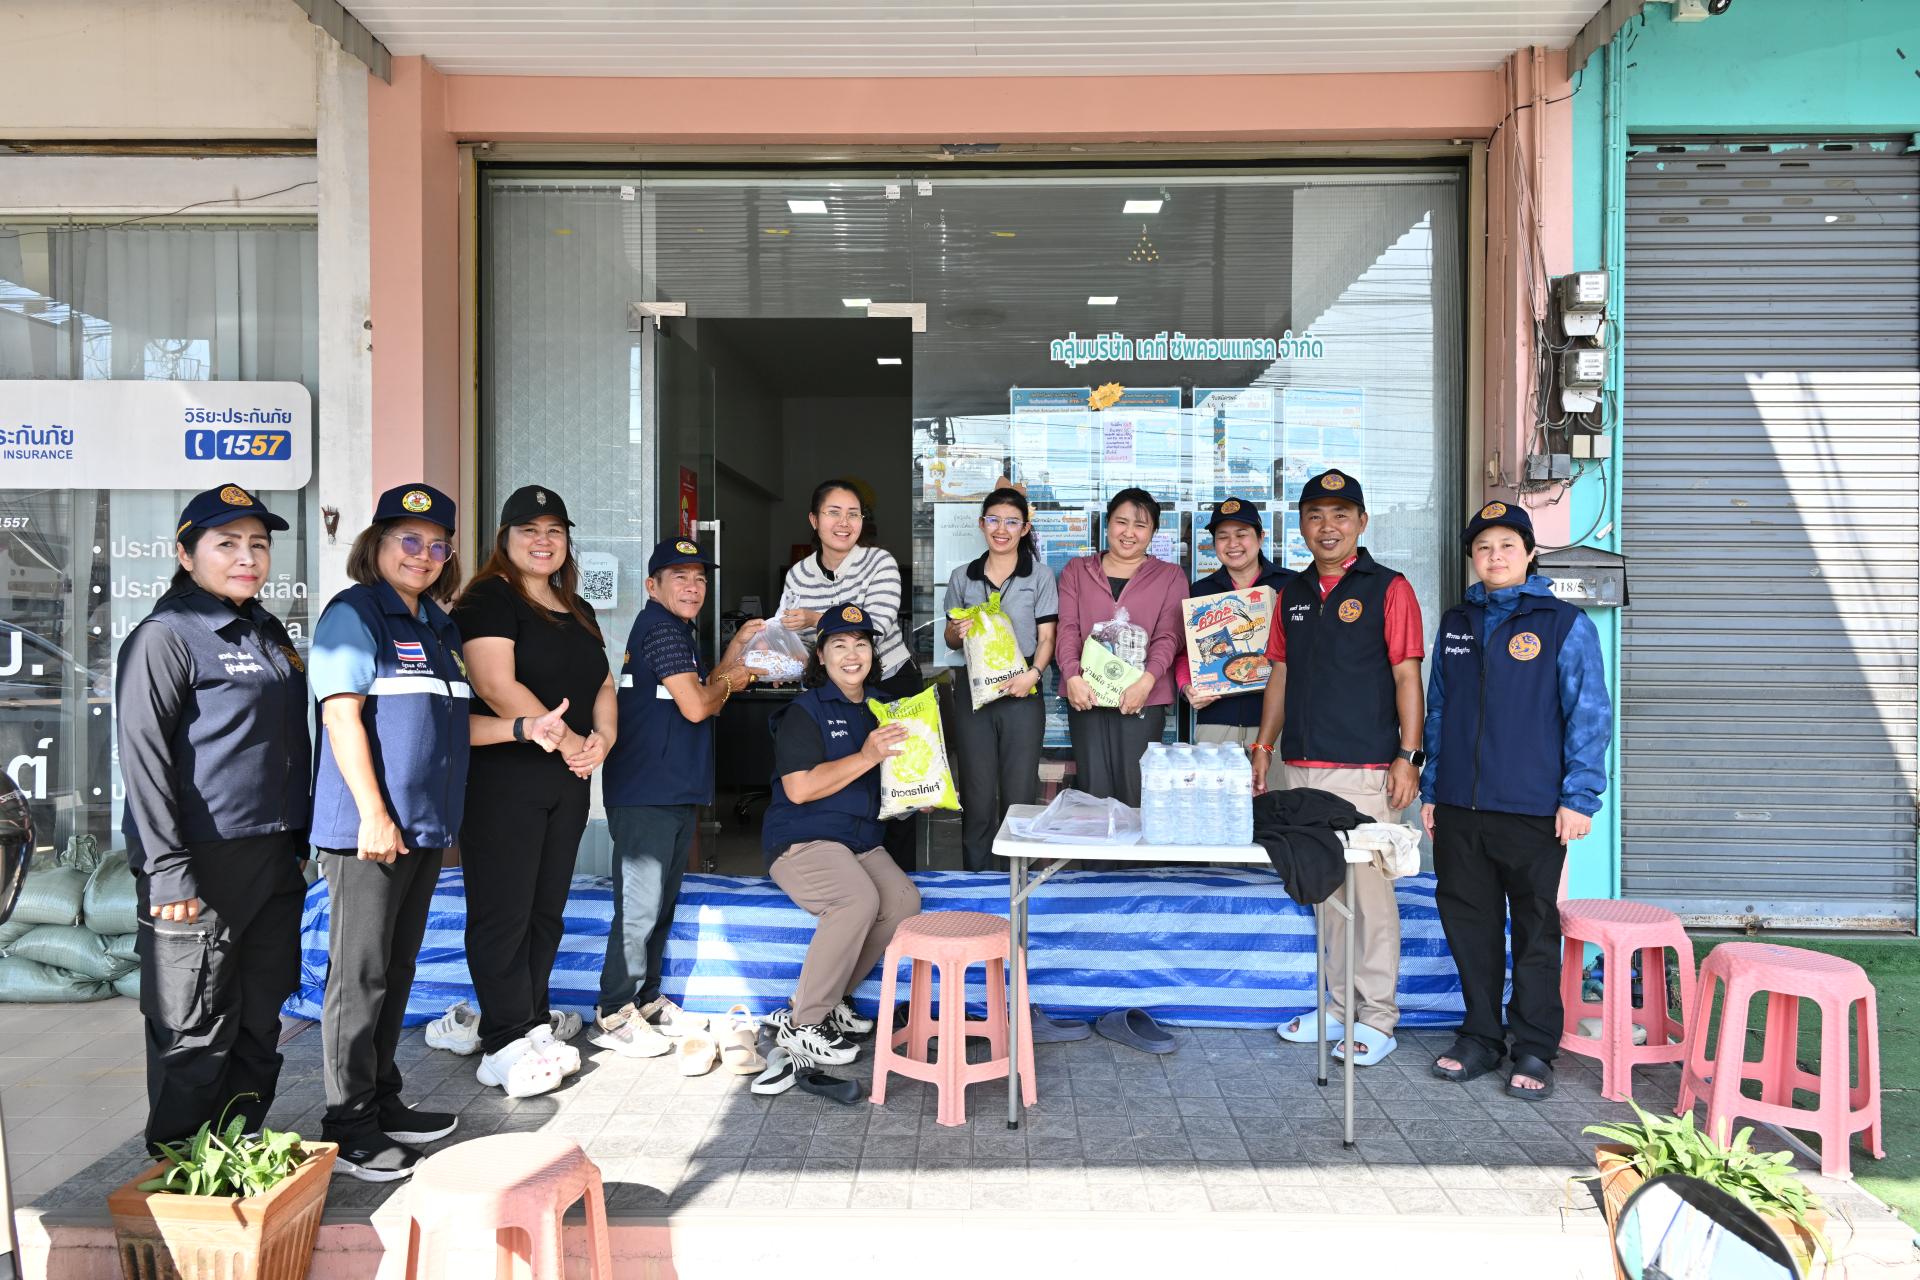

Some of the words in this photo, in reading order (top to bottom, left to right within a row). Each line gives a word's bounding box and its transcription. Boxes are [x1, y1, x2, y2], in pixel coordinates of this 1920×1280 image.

[1050, 332, 1133, 368] กลุ่มบริษัท
[1279, 330, 1324, 360] จำกัด
[184, 408, 292, 424] วิริยะประกันภัย
[3, 449, 73, 460] INSURANCE
[222, 435, 285, 456] 1557
[111, 535, 177, 558] ประกัน
[254, 574, 308, 598] ตล็ด
[891, 781, 940, 798] ข้าวตราไก่แจ้
